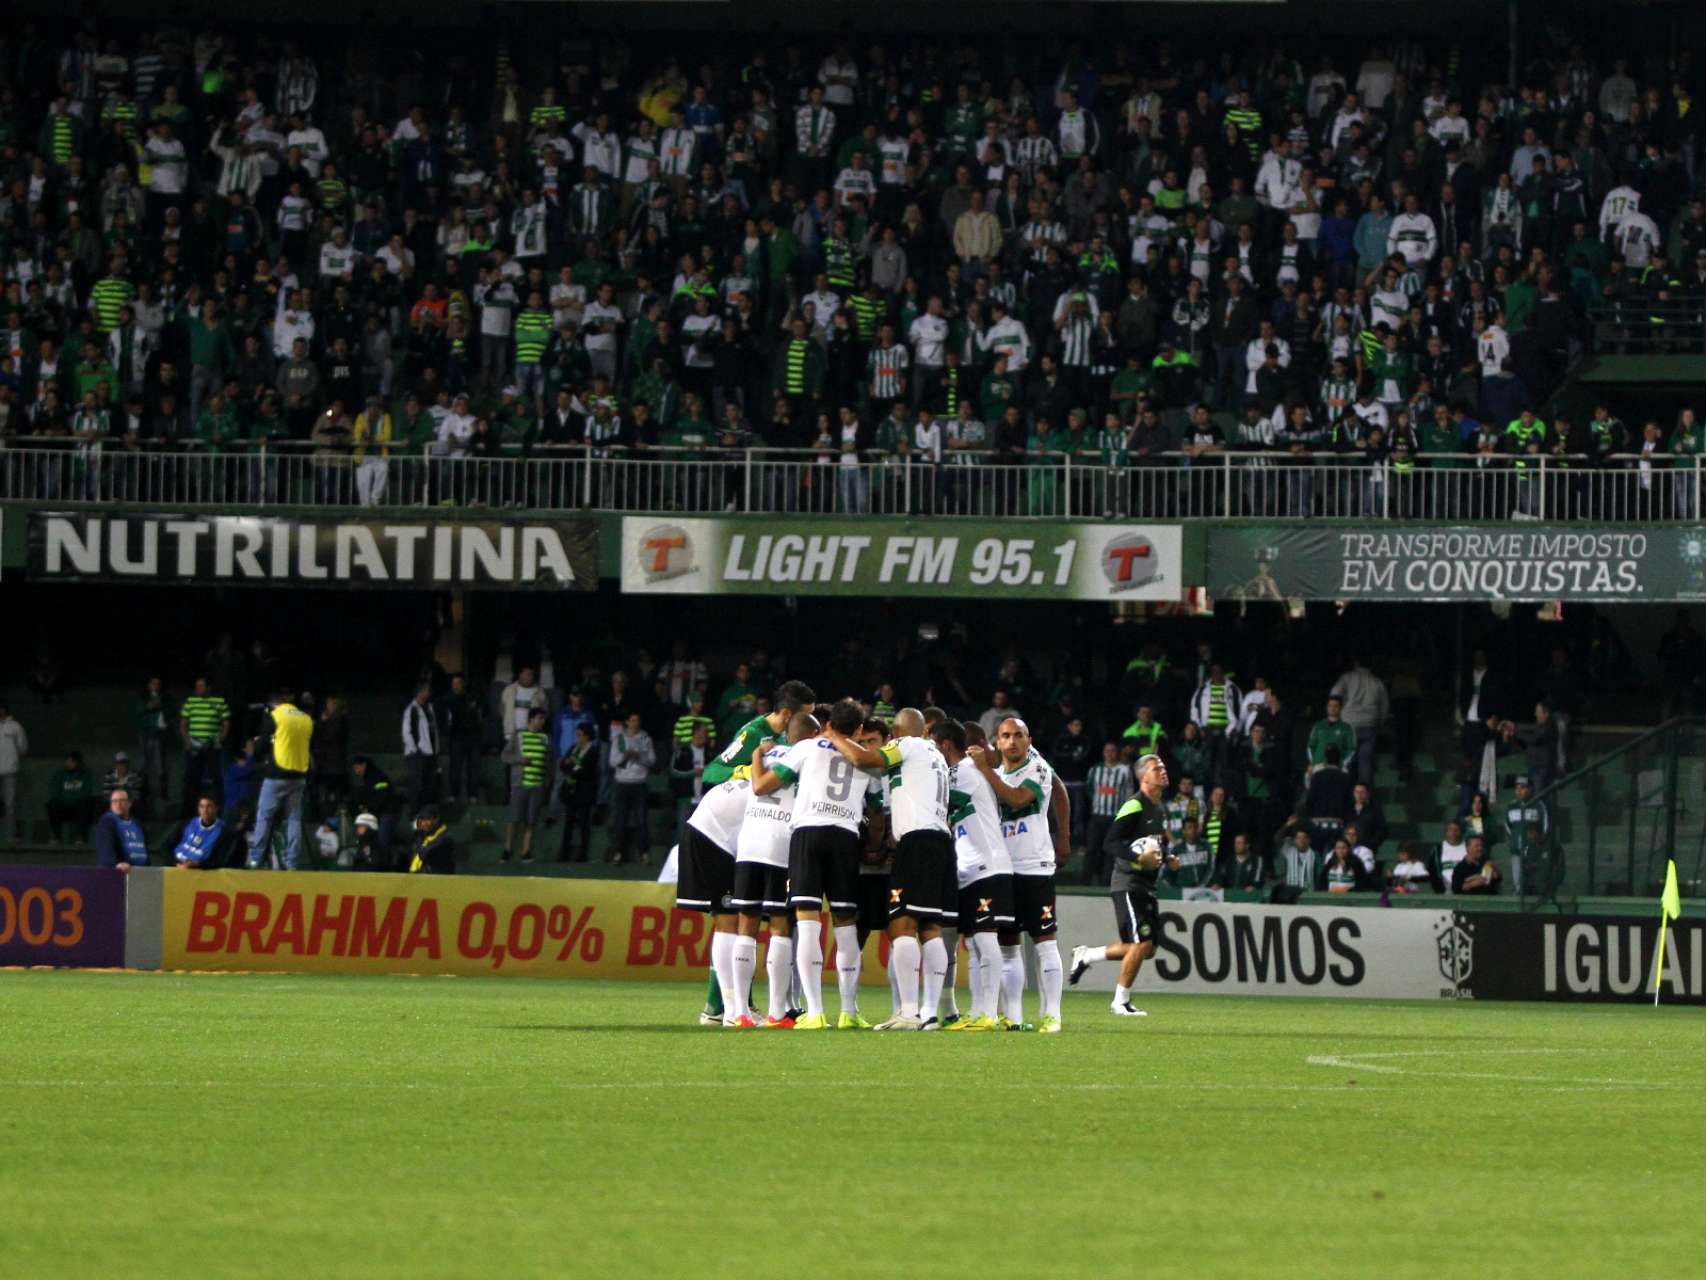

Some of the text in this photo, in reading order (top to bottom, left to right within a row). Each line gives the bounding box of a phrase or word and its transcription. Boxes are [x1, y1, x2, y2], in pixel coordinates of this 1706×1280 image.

[45, 517, 576, 582] NUTRILATINA
[643, 534, 687, 573] T
[723, 534, 871, 582] LIGHT
[878, 535, 960, 584] FM
[968, 538, 1078, 586] 95.1
[1109, 543, 1151, 582] T
[1339, 533, 1647, 559] TRANSFORME IMPOSTO
[1339, 560, 1644, 593] EM CONQUISTAS.
[826, 755, 854, 802] 9
[186, 890, 442, 960] BRAHMA
[456, 901, 606, 970] 0,0%
[1155, 911, 1366, 986] SOMOS
